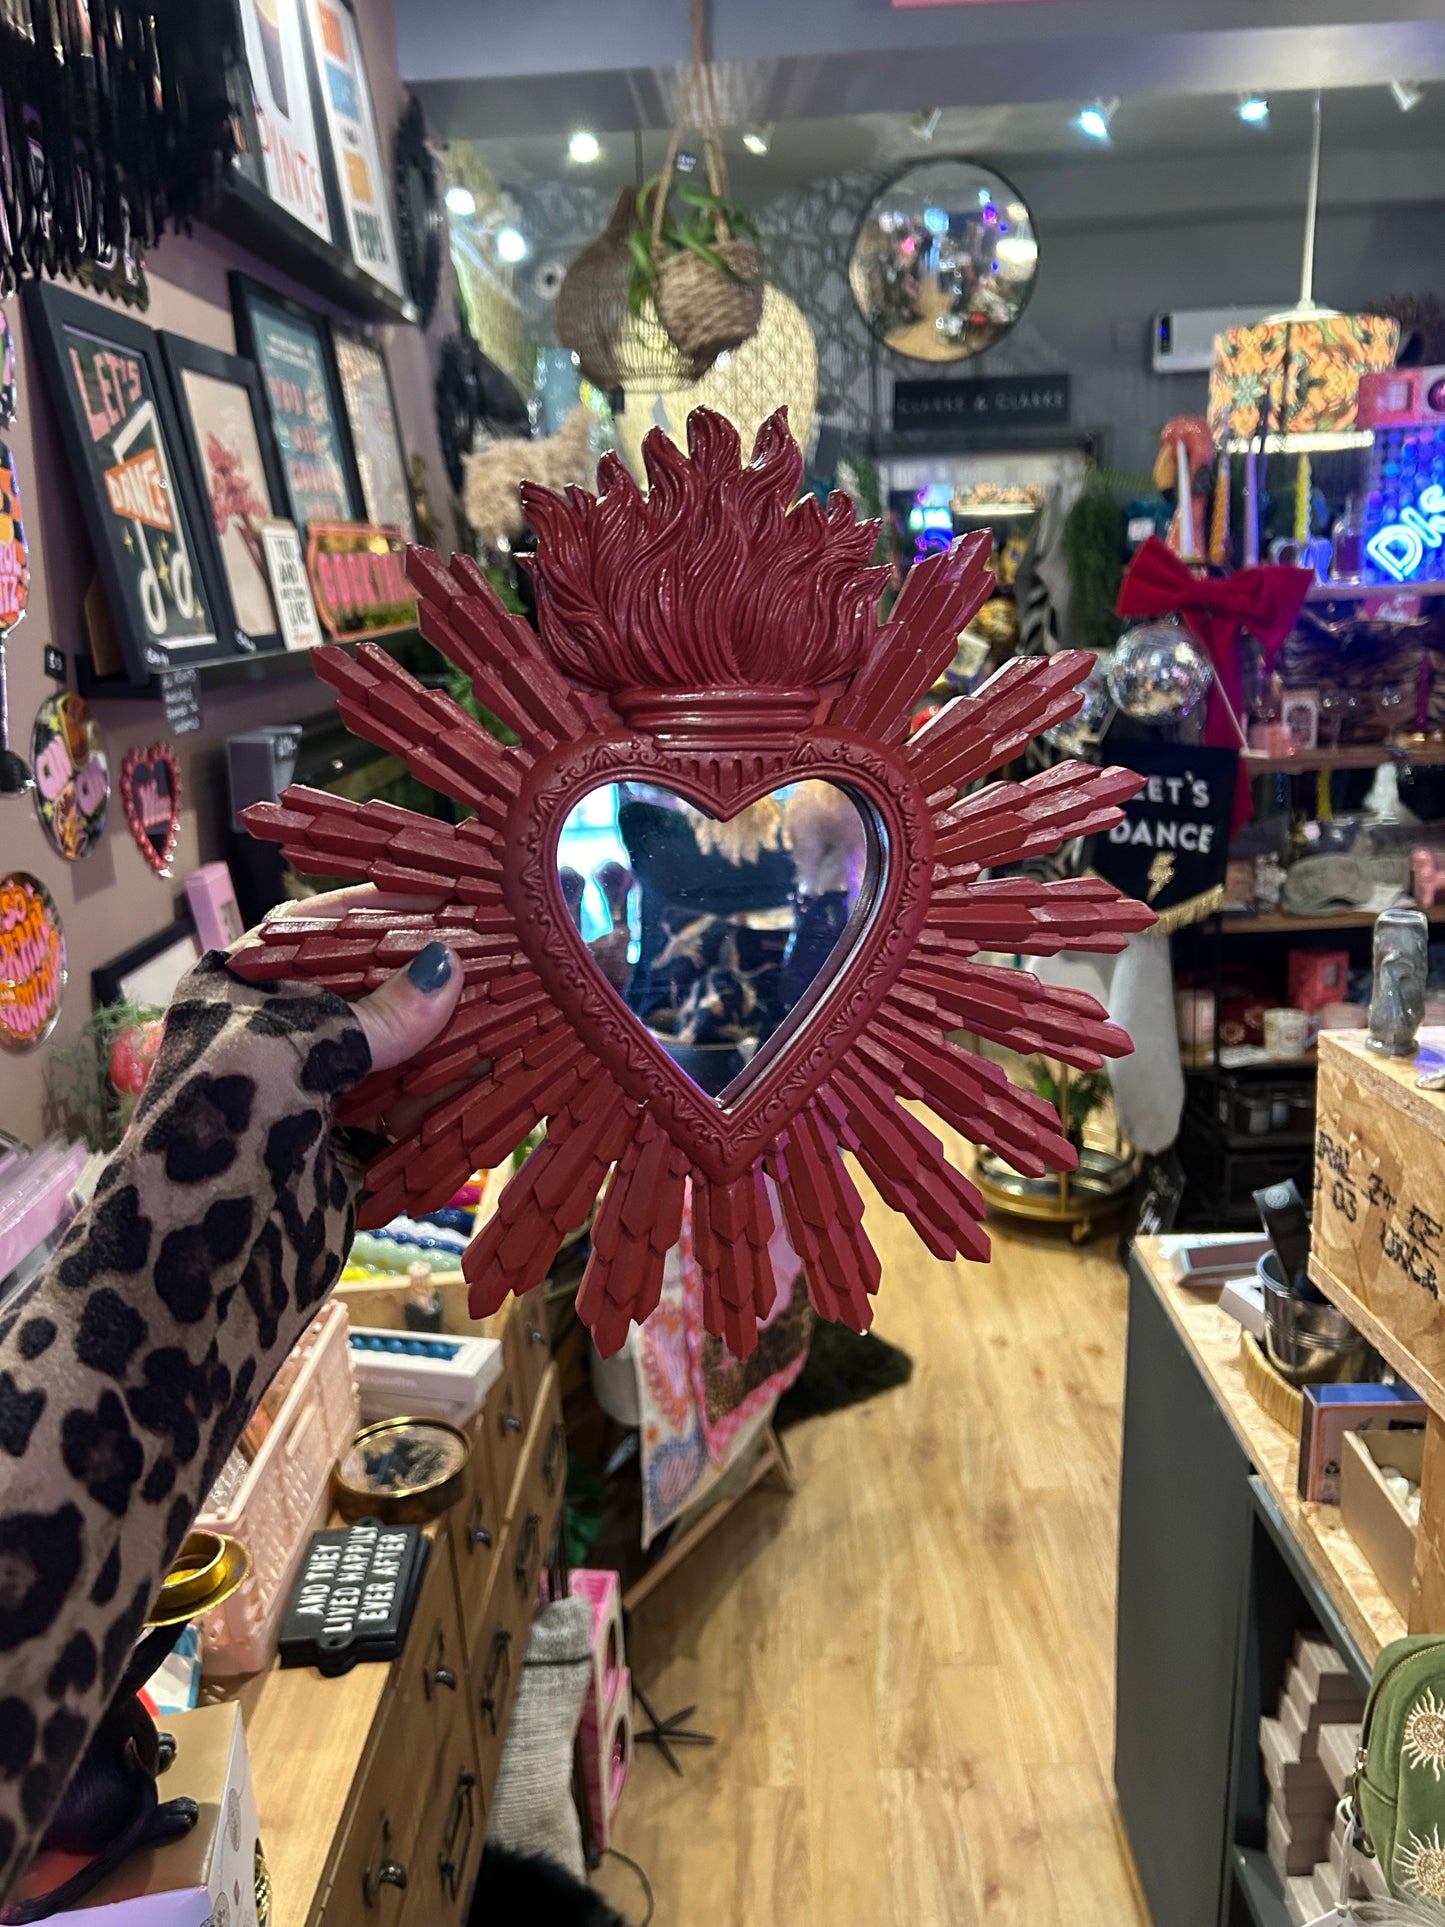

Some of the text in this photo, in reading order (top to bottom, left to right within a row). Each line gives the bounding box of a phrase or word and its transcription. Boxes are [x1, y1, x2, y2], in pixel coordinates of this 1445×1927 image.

[69, 347, 142, 442] LET'S
[105, 457, 171, 525] DANCE
[1108, 817, 1215, 853] DANCE
[295, 1544, 343, 1617] AND THEY
[321, 1525, 379, 1634] LIVED HAPPILY
[357, 1533, 408, 1621] EVER AFTER
